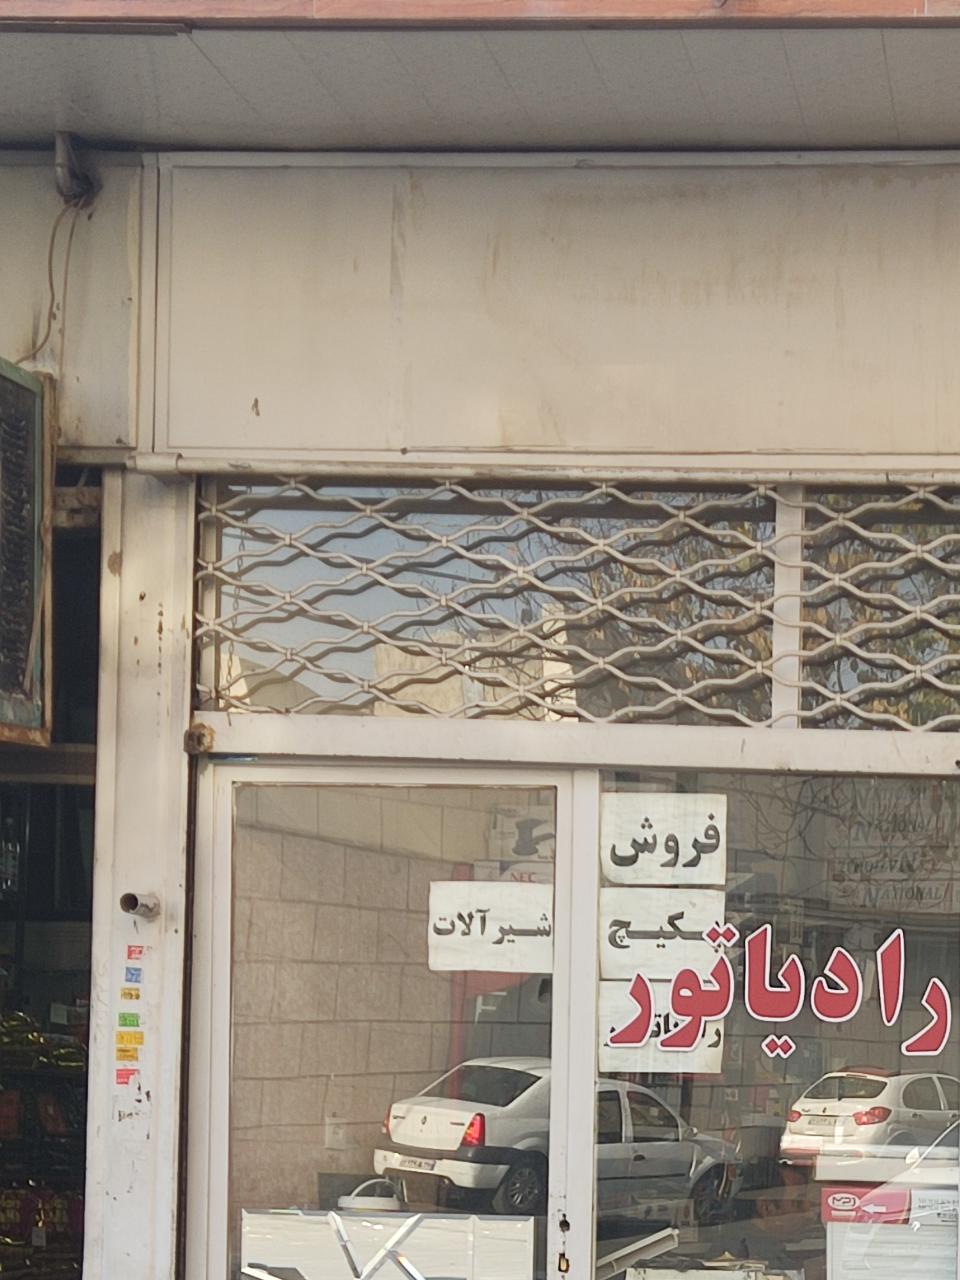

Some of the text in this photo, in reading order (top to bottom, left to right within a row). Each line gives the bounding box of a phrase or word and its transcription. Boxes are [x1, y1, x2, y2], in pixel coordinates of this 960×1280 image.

[610, 812, 720, 868] فروش
[432, 908, 552, 945] شیر آلات
[607, 923, 952, 1059] رادیاتور
